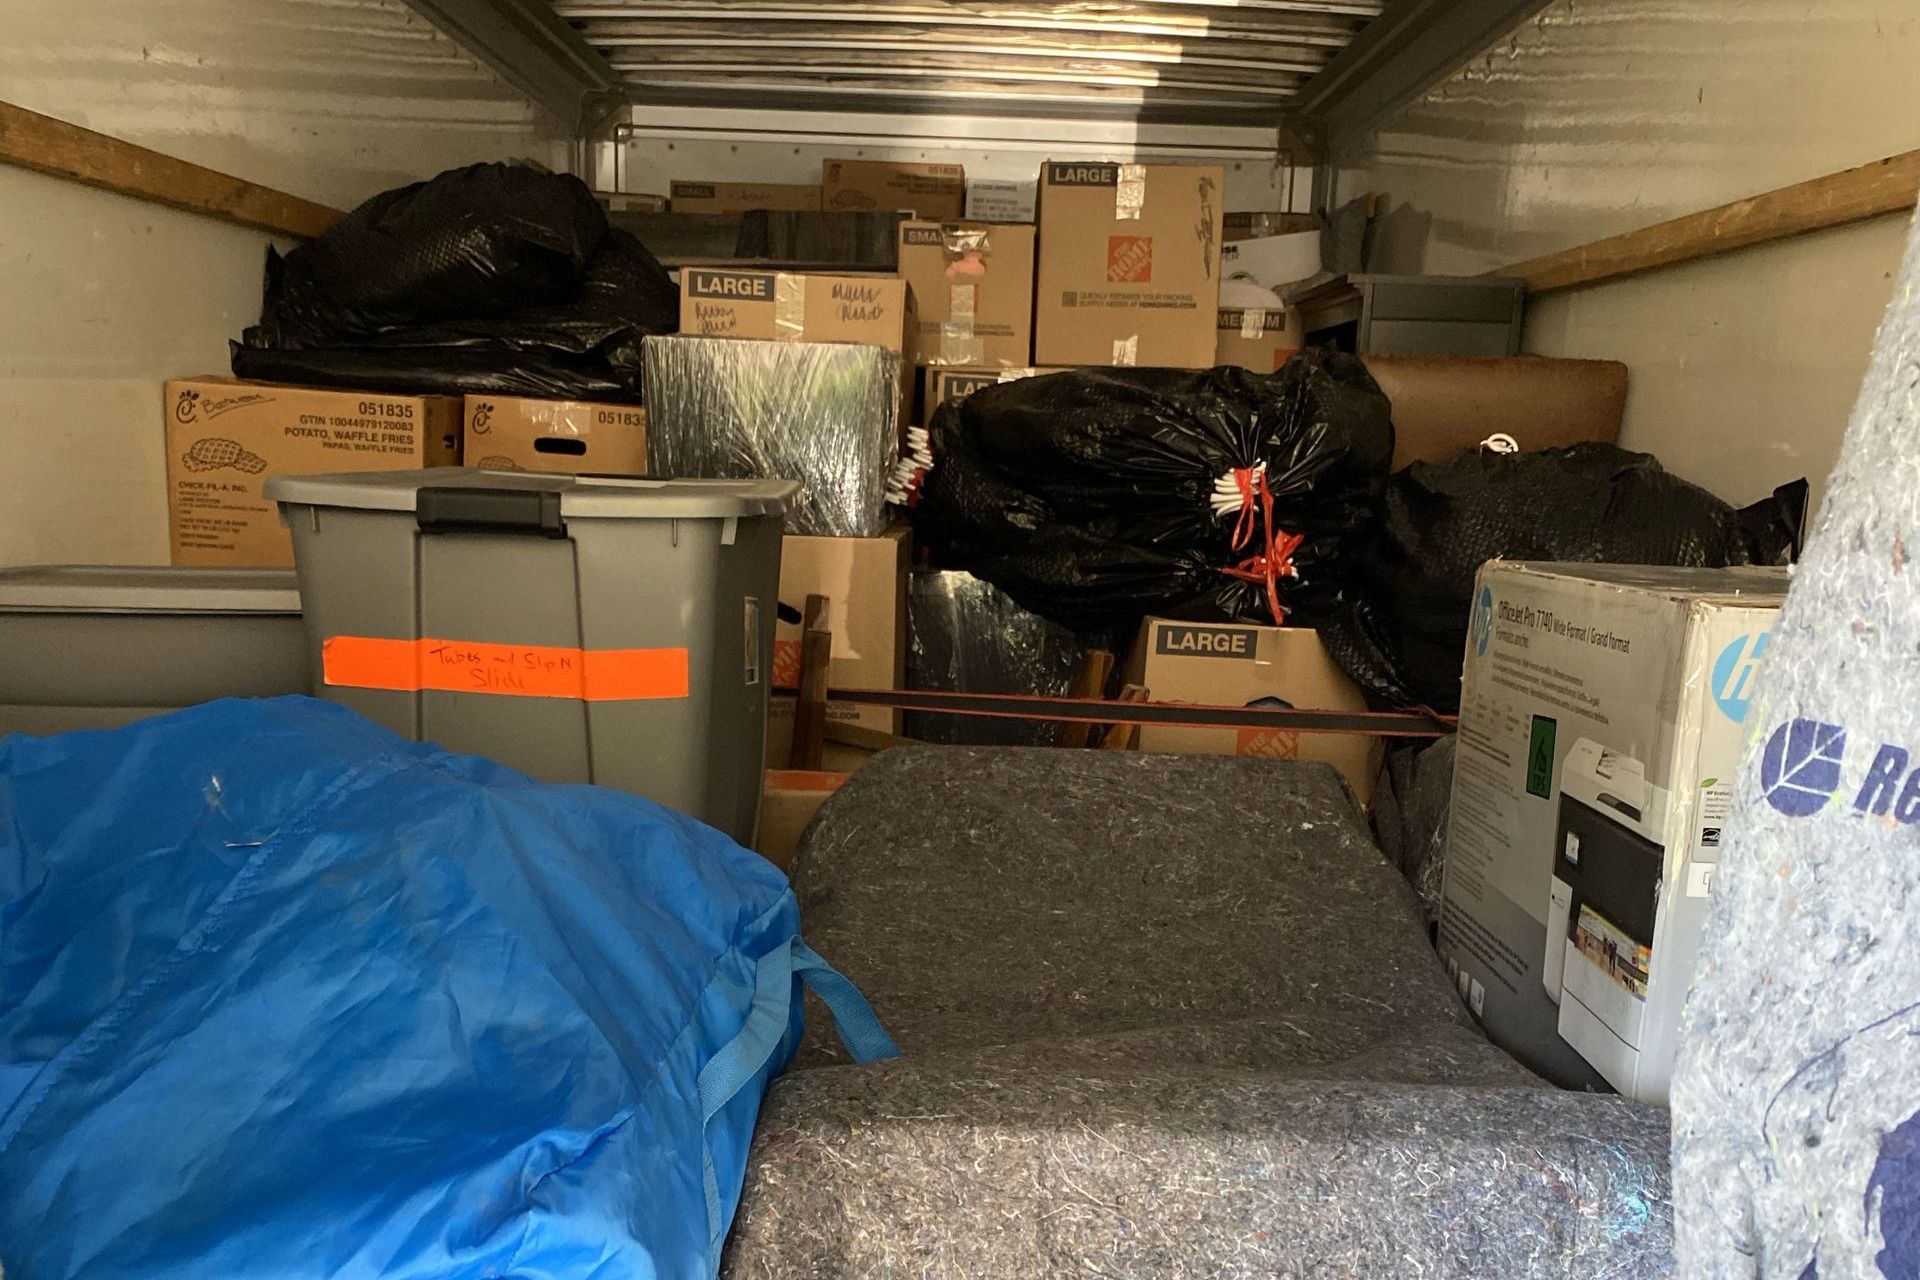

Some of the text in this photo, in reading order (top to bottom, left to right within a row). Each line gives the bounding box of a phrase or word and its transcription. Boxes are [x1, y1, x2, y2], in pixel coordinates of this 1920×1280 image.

[1054, 167, 1112, 183] LARGE
[696, 275, 767, 297] LARGE
[358, 401, 414, 419] 051835
[598, 411, 643, 427] 05183
[300, 414, 326, 425] GTIN
[284, 426, 414, 445] POTATO, WAFFLE FRIES
[1166, 631, 1247, 653] LARGE
